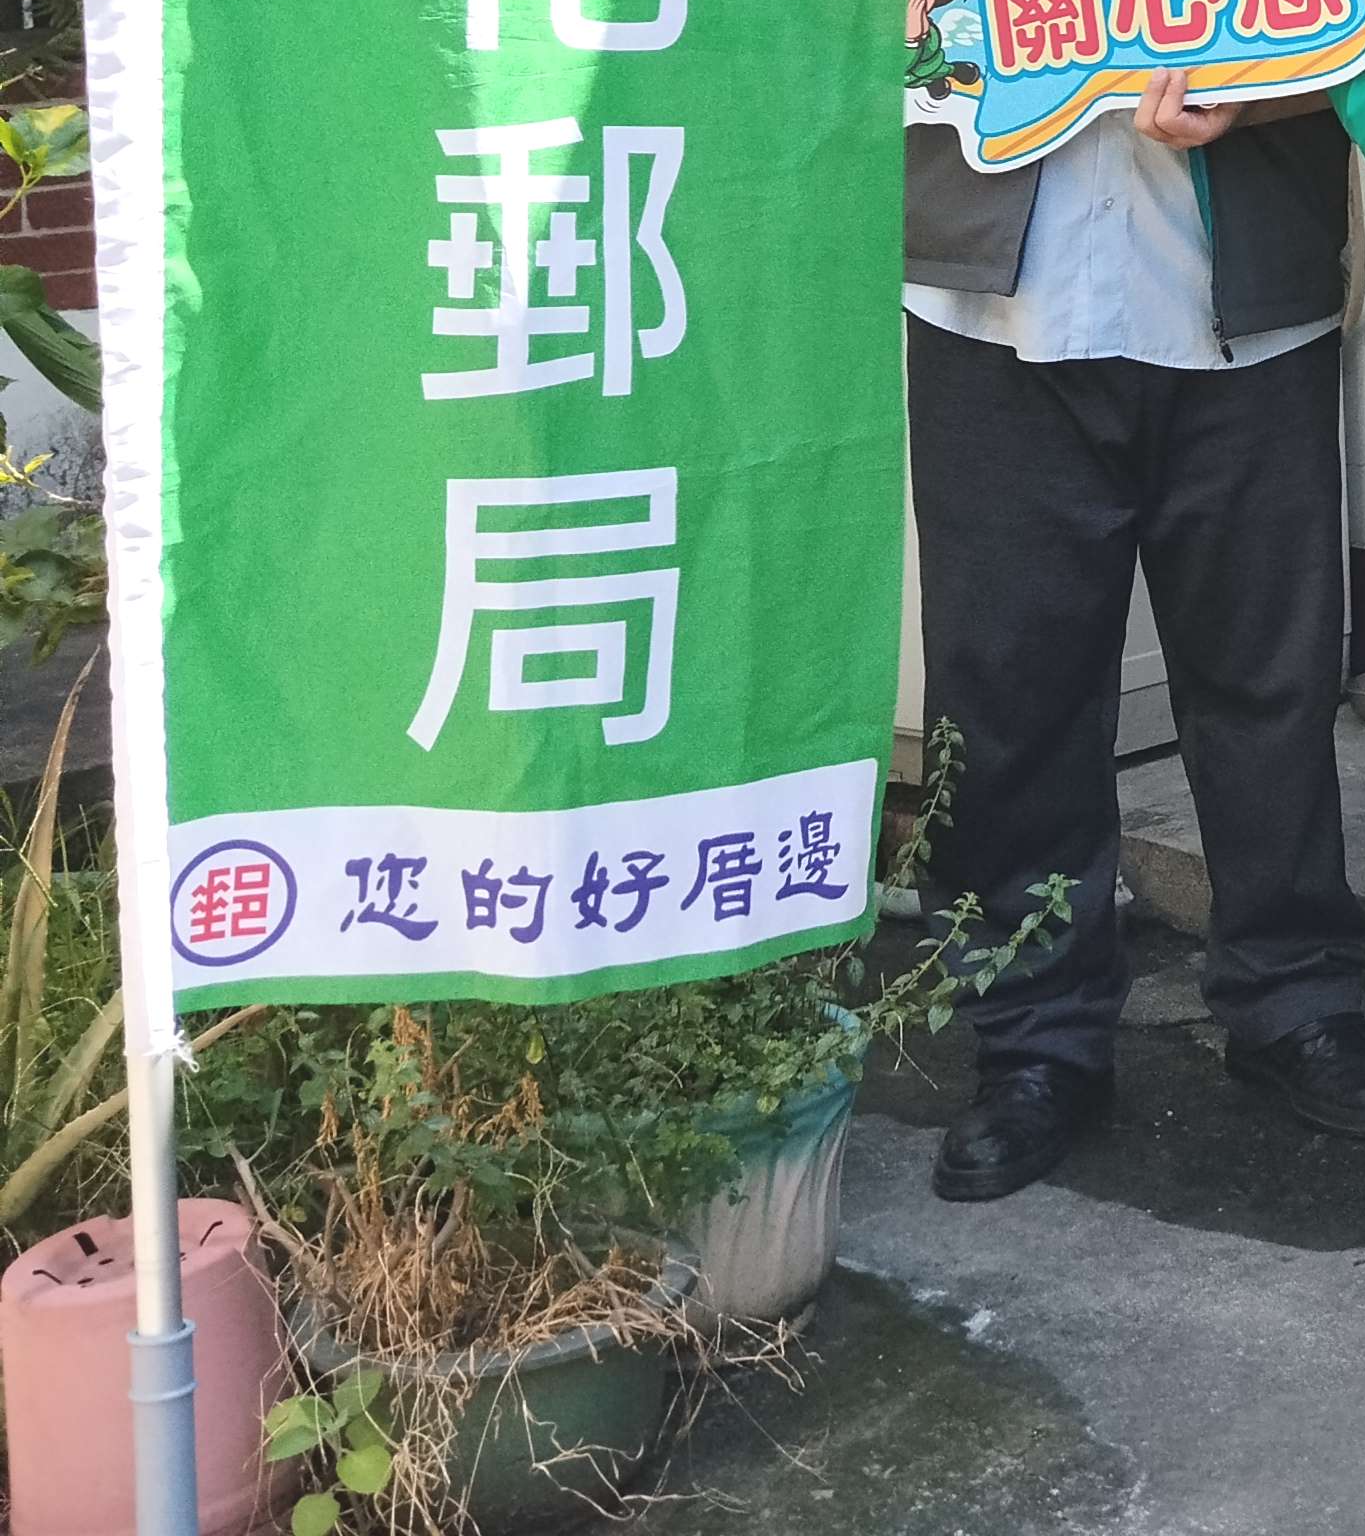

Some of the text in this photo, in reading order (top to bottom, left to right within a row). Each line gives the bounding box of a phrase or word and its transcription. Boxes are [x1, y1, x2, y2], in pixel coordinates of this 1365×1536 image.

[339, 809, 851, 945] 您的好厝邊
